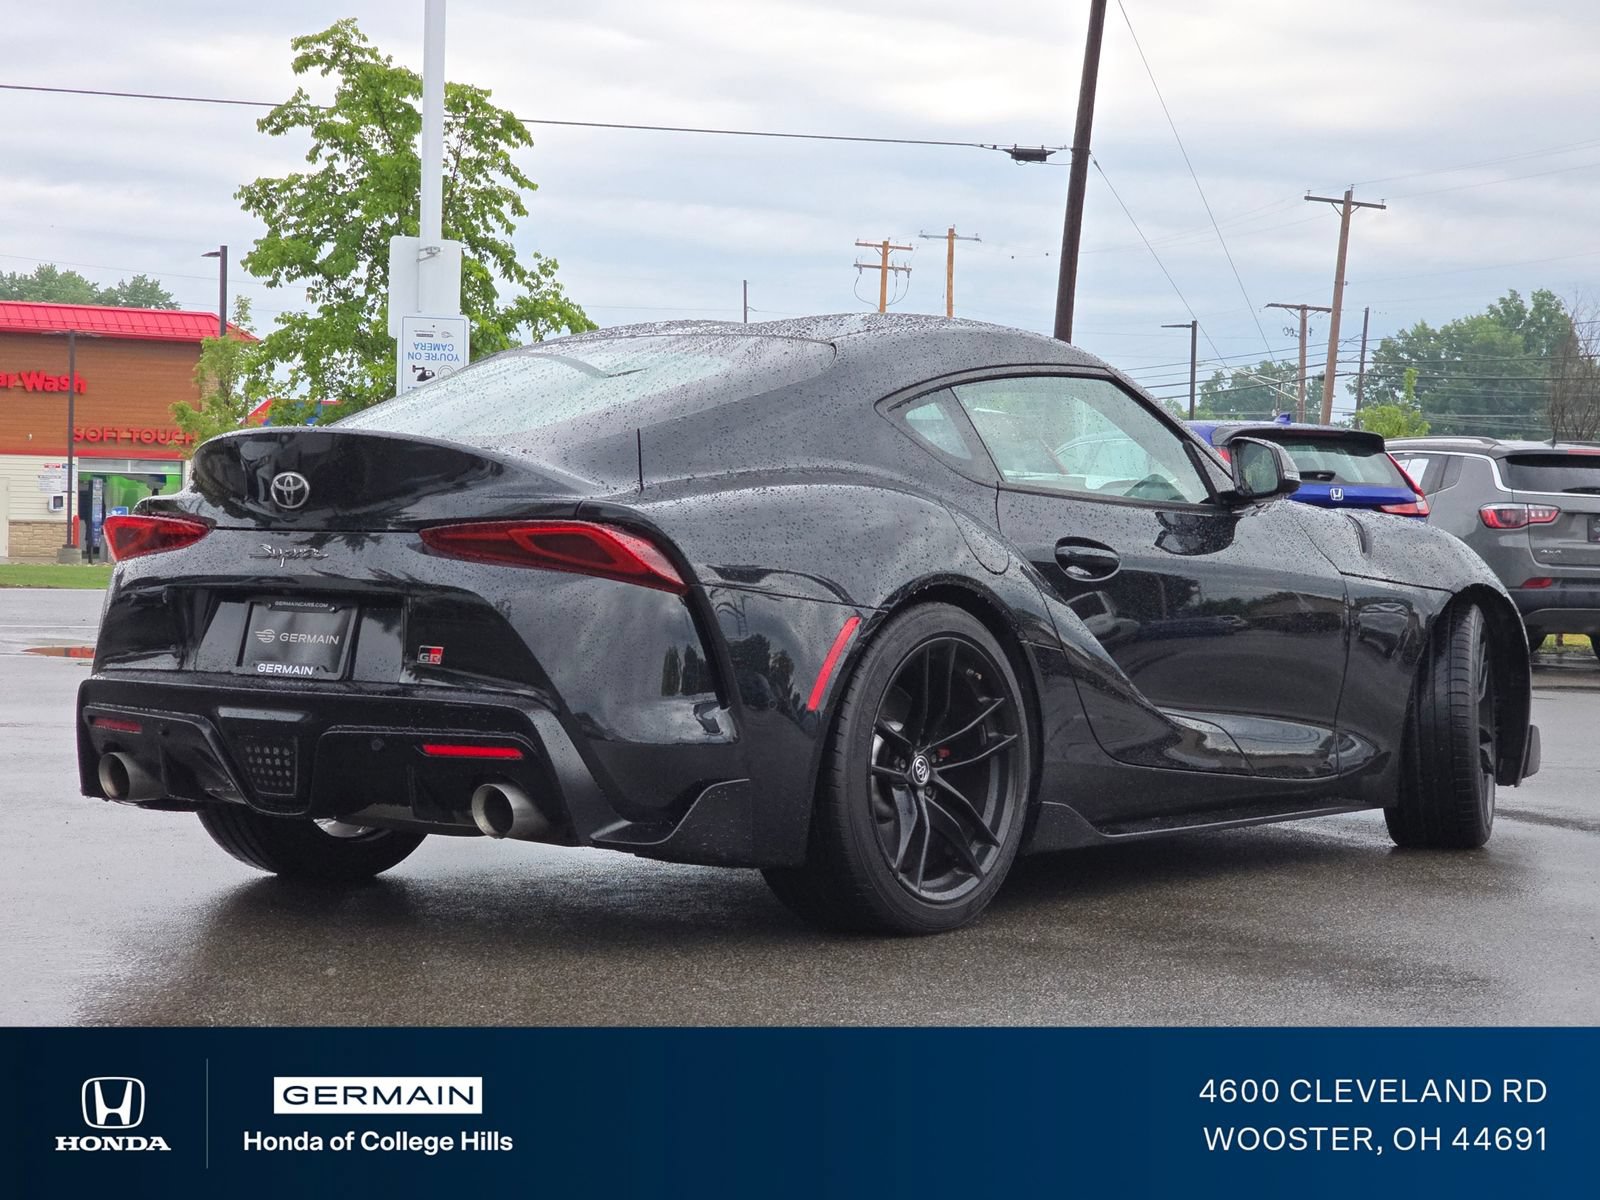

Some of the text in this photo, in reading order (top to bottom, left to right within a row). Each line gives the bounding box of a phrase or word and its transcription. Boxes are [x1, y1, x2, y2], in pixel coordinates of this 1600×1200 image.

[413, 342, 455, 352] CAMERA
[407, 352, 460, 362] YOU'RE ON
[20, 370, 88, 394] Wash
[73, 427, 123, 444] SOFT
[279, 632, 340, 645] GERMAIN
[257, 663, 314, 676] GERMAIN
